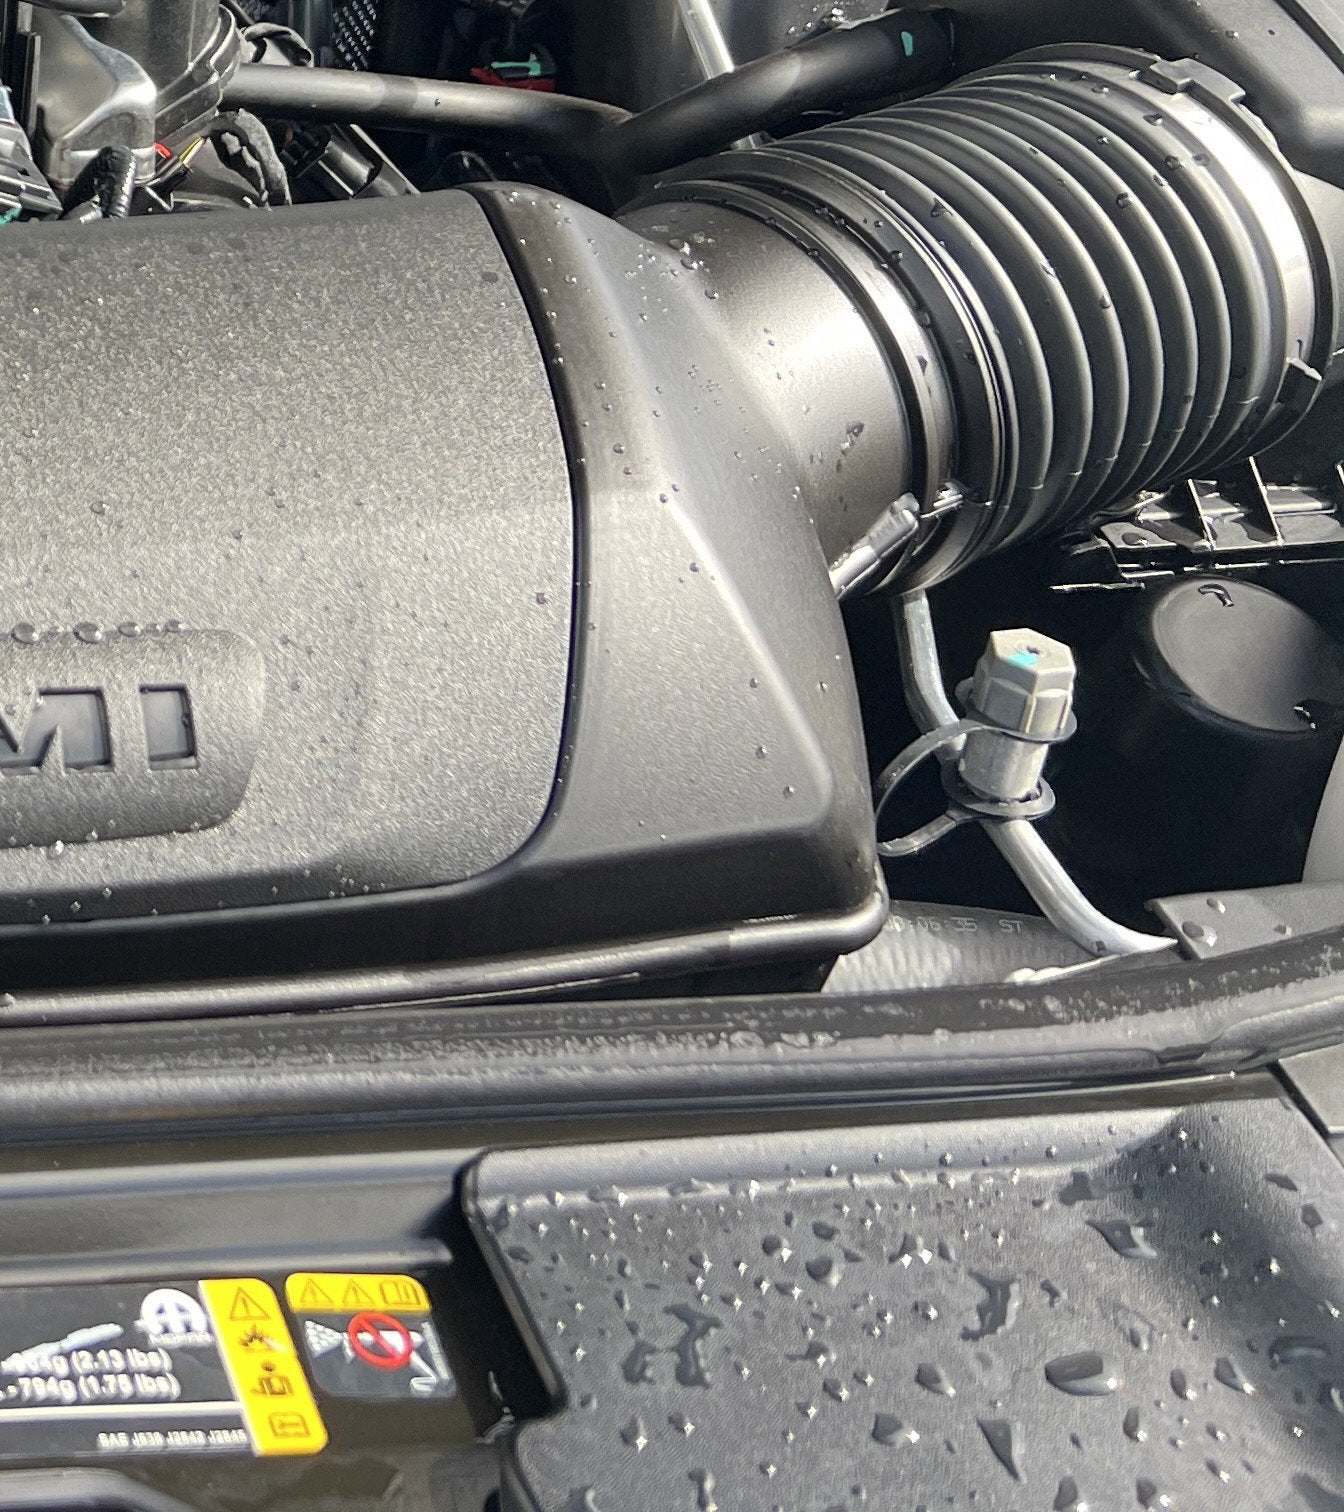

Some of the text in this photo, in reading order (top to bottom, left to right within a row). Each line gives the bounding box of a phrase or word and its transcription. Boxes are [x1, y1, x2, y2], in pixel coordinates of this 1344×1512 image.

[998, 918, 1023, 933] ST
[125, 1347, 173, 1373] lbs)
[134, 1372, 182, 1400] lbs)
